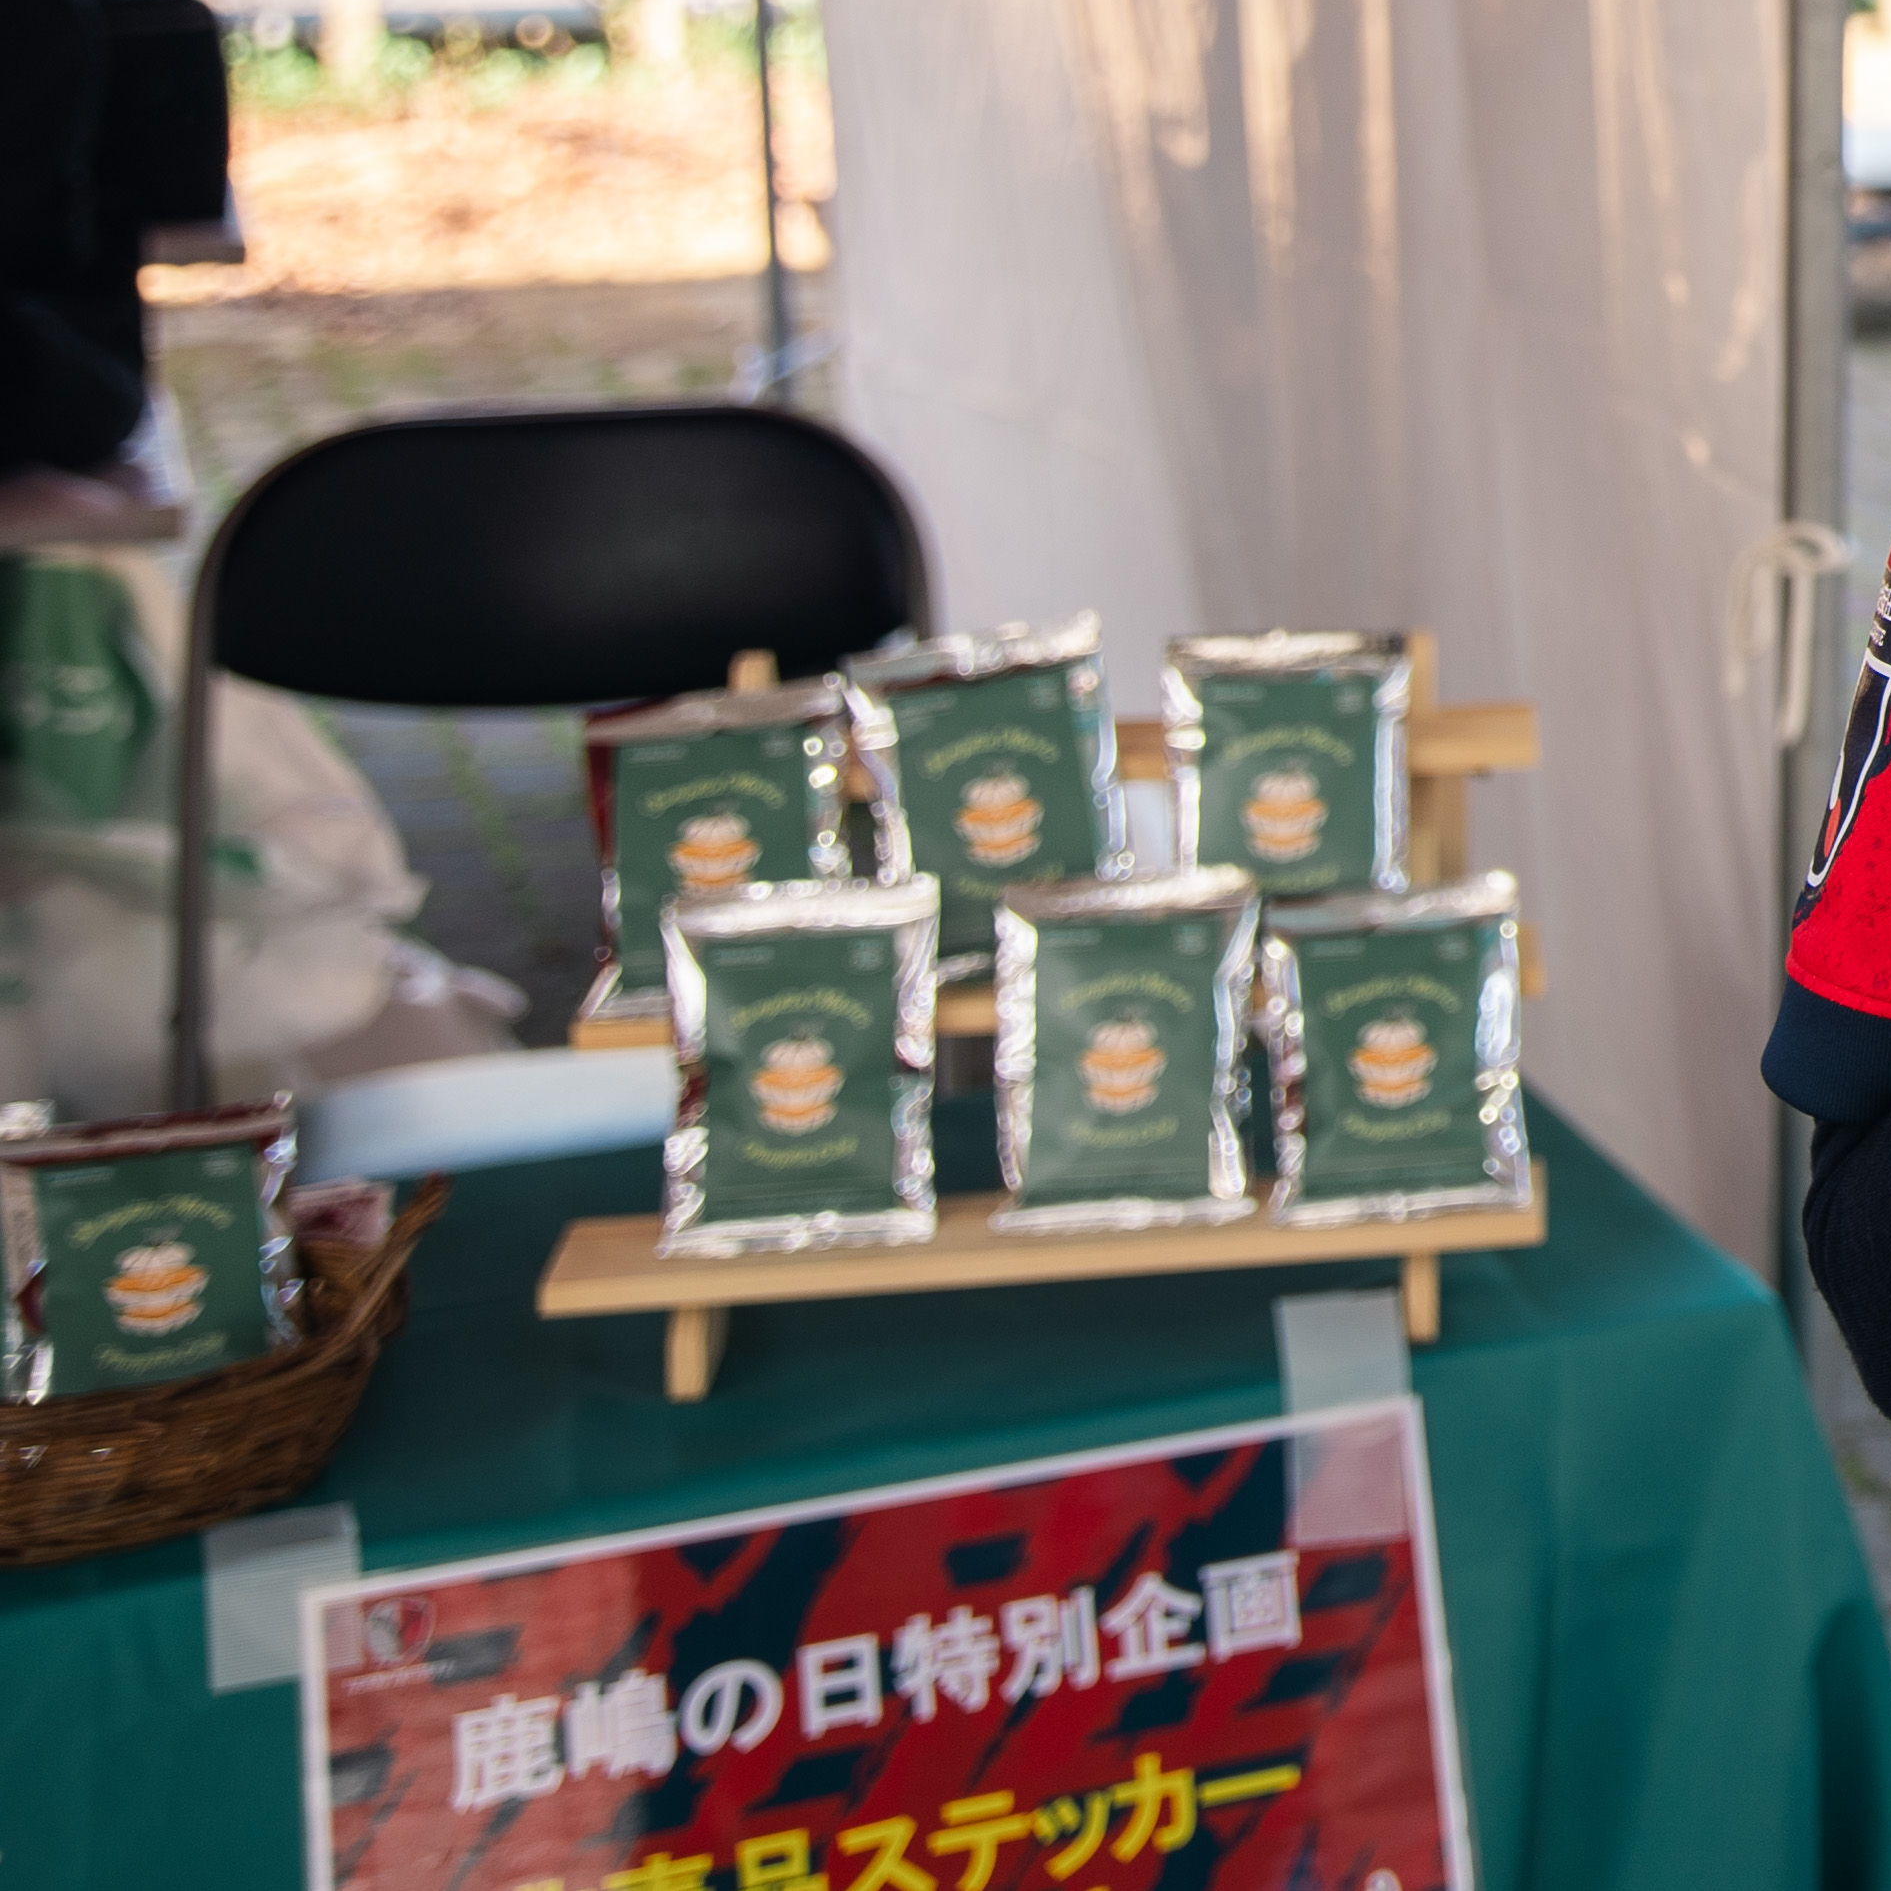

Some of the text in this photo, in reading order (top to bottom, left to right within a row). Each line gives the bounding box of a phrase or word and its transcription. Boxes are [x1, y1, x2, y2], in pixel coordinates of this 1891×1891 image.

[448, 1548, 1303, 1815] 鹿嶋の日特別企画
[512, 1751, 1301, 1891] 品ステッカー
